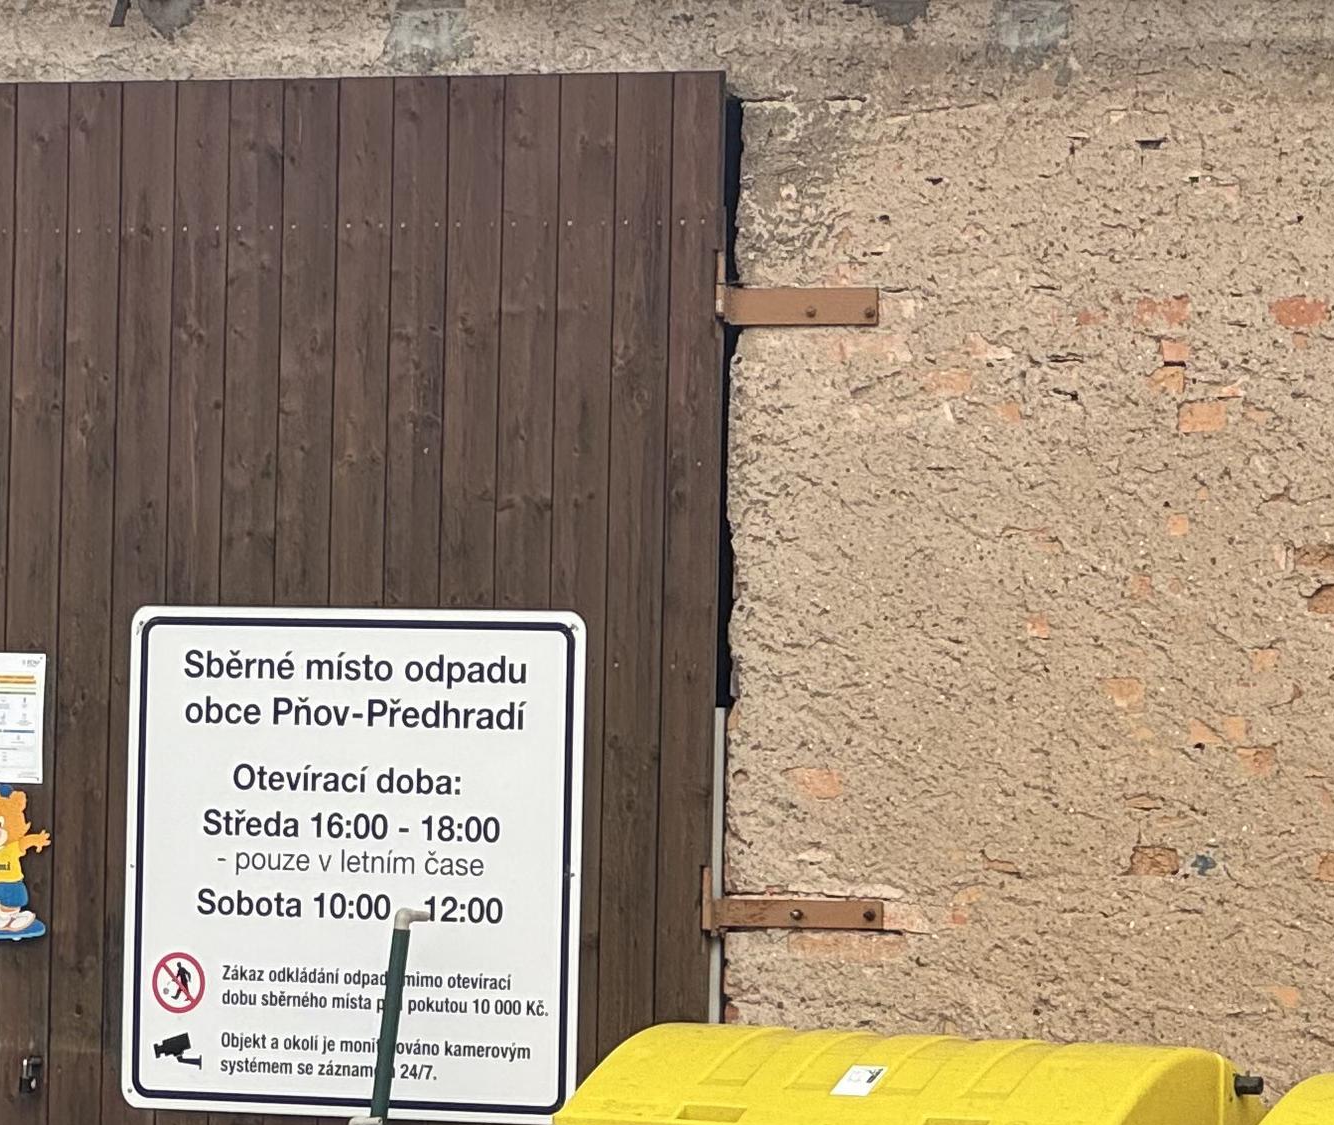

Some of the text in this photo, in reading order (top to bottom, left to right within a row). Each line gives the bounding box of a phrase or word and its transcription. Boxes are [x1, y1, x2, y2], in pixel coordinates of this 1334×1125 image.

[183, 649, 527, 690] Sběrné místo odpadu
[185, 695, 527, 731] obce Pňov-Předhradí
[232, 763, 461, 796] Otevírací doba:
[203, 808, 299, 838] Středa
[310, 812, 389, 841] 16:00
[421, 815, 501, 844] 18:00
[235, 851, 310, 876] pouze
[318, 854, 332, 872] v
[341, 848, 415, 875] letním
[424, 850, 485, 877] čase
[196, 887, 504, 925] Sobota 10:00 12:00
[222, 964, 512, 991] Zákaz odkládání odpad mimo otevírací
[221, 989, 257, 1006] dobu
[260, 990, 328, 1009] sběrného
[331, 992, 372, 1010] místa
[407, 996, 468, 1016] pokutou
[472, 998, 491, 1015] 10
[494, 999, 522, 1016] 000
[525, 996, 550, 1017] Kč.
[221, 1031, 531, 1063] Objekt a okolí je moniováno kamerovým
[220, 1056, 437, 1081] systémem se záznam 24/7.
